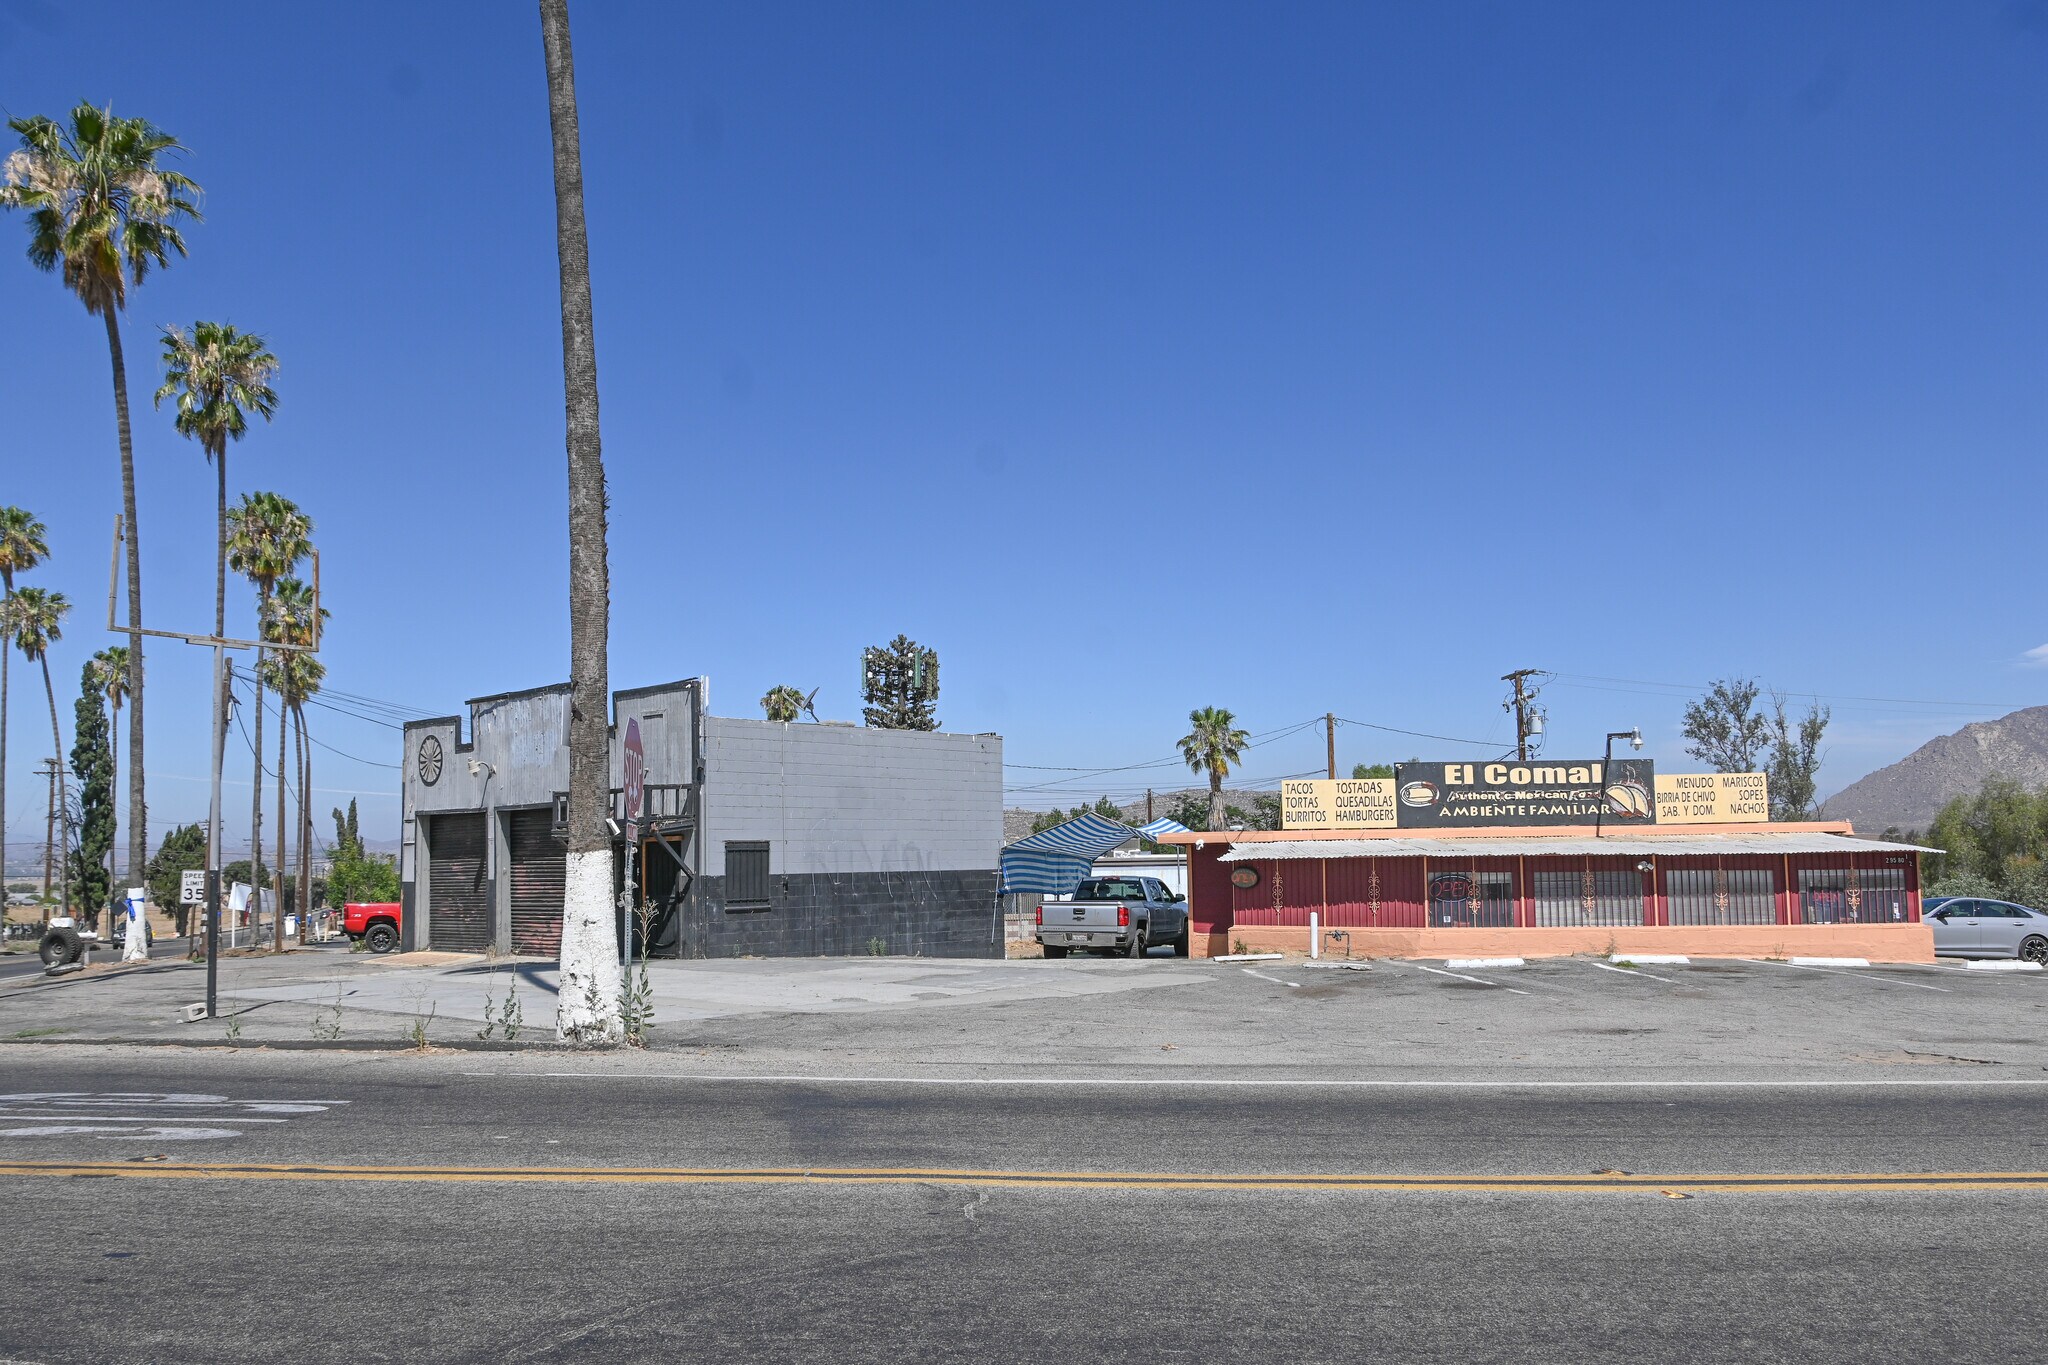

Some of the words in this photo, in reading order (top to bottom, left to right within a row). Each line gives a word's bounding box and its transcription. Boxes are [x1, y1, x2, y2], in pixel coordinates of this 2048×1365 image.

[625, 748, 643, 789] STOP
[1445, 764, 1474, 785] El
[1484, 763, 1603, 785] Comal
[1336, 781, 1382, 794] TOSTADAS
[1676, 777, 1714, 788] MENUDO
[1722, 776, 1763, 787] MARISCOS
[1285, 783, 1313, 794] TACOS
[1739, 789, 1763, 800] SOPES
[1336, 796, 1392, 807] QUESADILLAS
[1451, 791, 1510, 801] Authentc
[1515, 790, 1568, 800] Mexican
[1657, 792, 1680, 803] BIRRIA
[1681, 791, 1691, 802] DE
[1692, 791, 1715, 802] CHIVO
[1285, 797, 1318, 808] TORTAS
[1730, 803, 1765, 814] NACHOS
[1286, 810, 1326, 822] BURRITOS
[1336, 809, 1394, 821] HAMBURGERS
[1440, 805, 1526, 817] AMBIENTE
[1529, 803, 1610, 816] FAMILIAR
[1662, 805, 1680, 817] SAB.
[1684, 805, 1689, 816] Y
[1693, 804, 1715, 816] DOM.
[1231, 872, 1257, 883] OPEN
[184, 888, 204, 900] 35
[1430, 881, 1473, 898] OPEN
